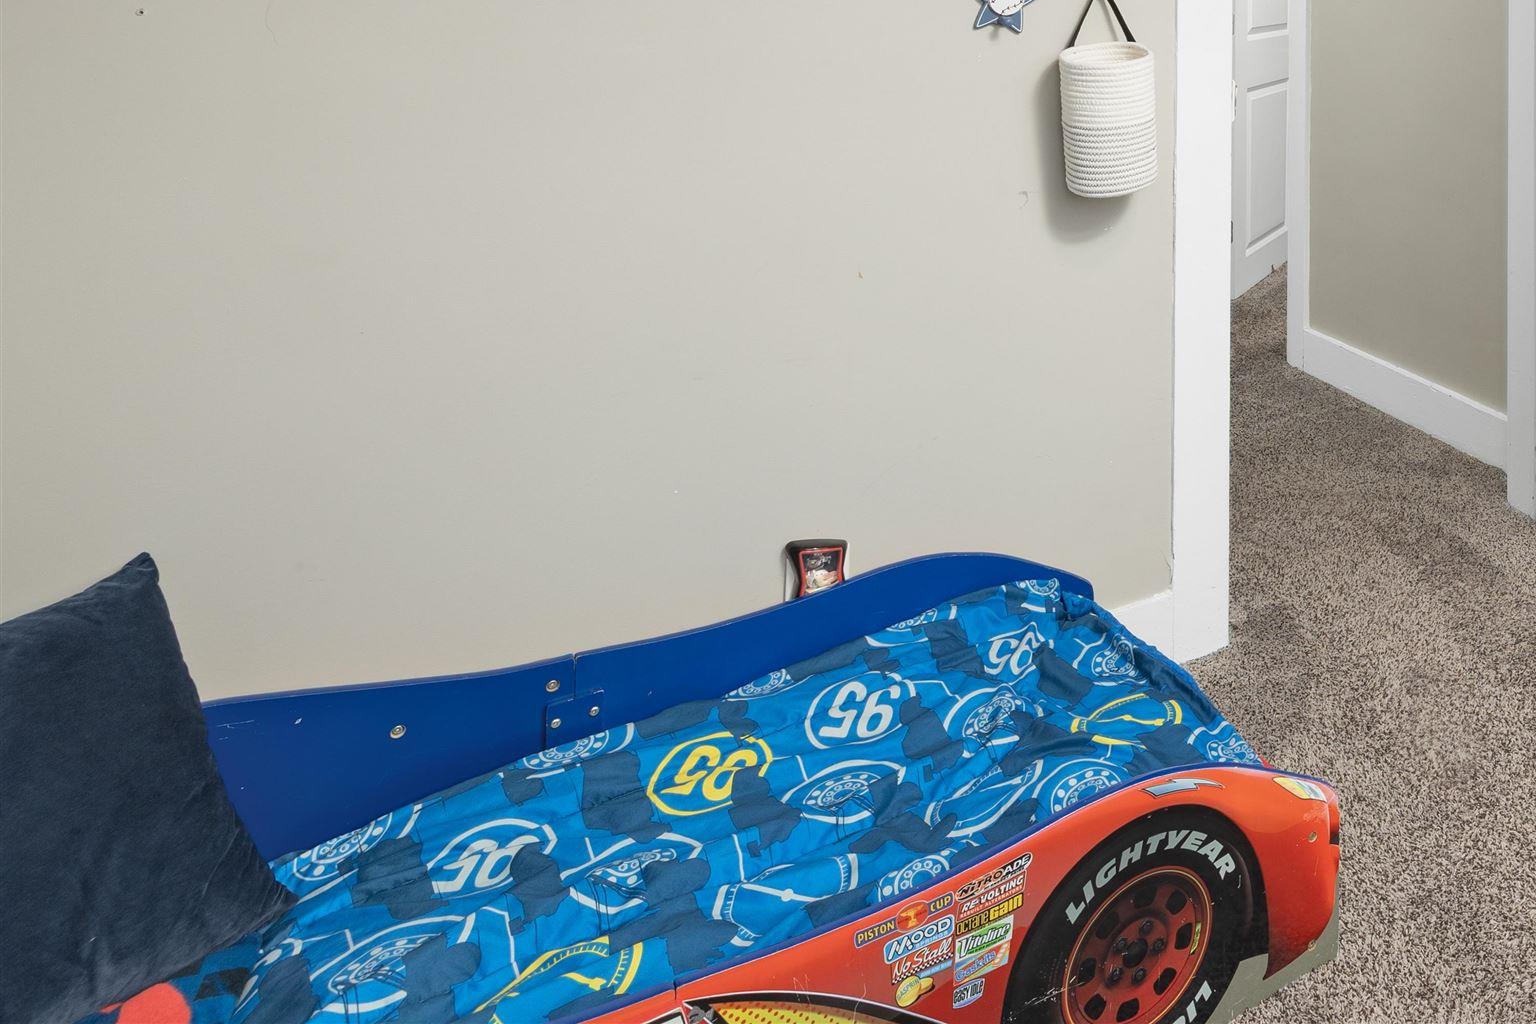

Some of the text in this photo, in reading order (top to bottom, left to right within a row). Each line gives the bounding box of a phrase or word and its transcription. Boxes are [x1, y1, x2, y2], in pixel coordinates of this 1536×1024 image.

[818, 681, 900, 738] 95
[1065, 829, 1236, 925] LIGHTYEAR
[857, 895, 951, 945] PISTON CUP
[888, 918, 951, 960] MOOD
[958, 923, 1011, 959] Vitoline
[912, 936, 952, 967] Stall
